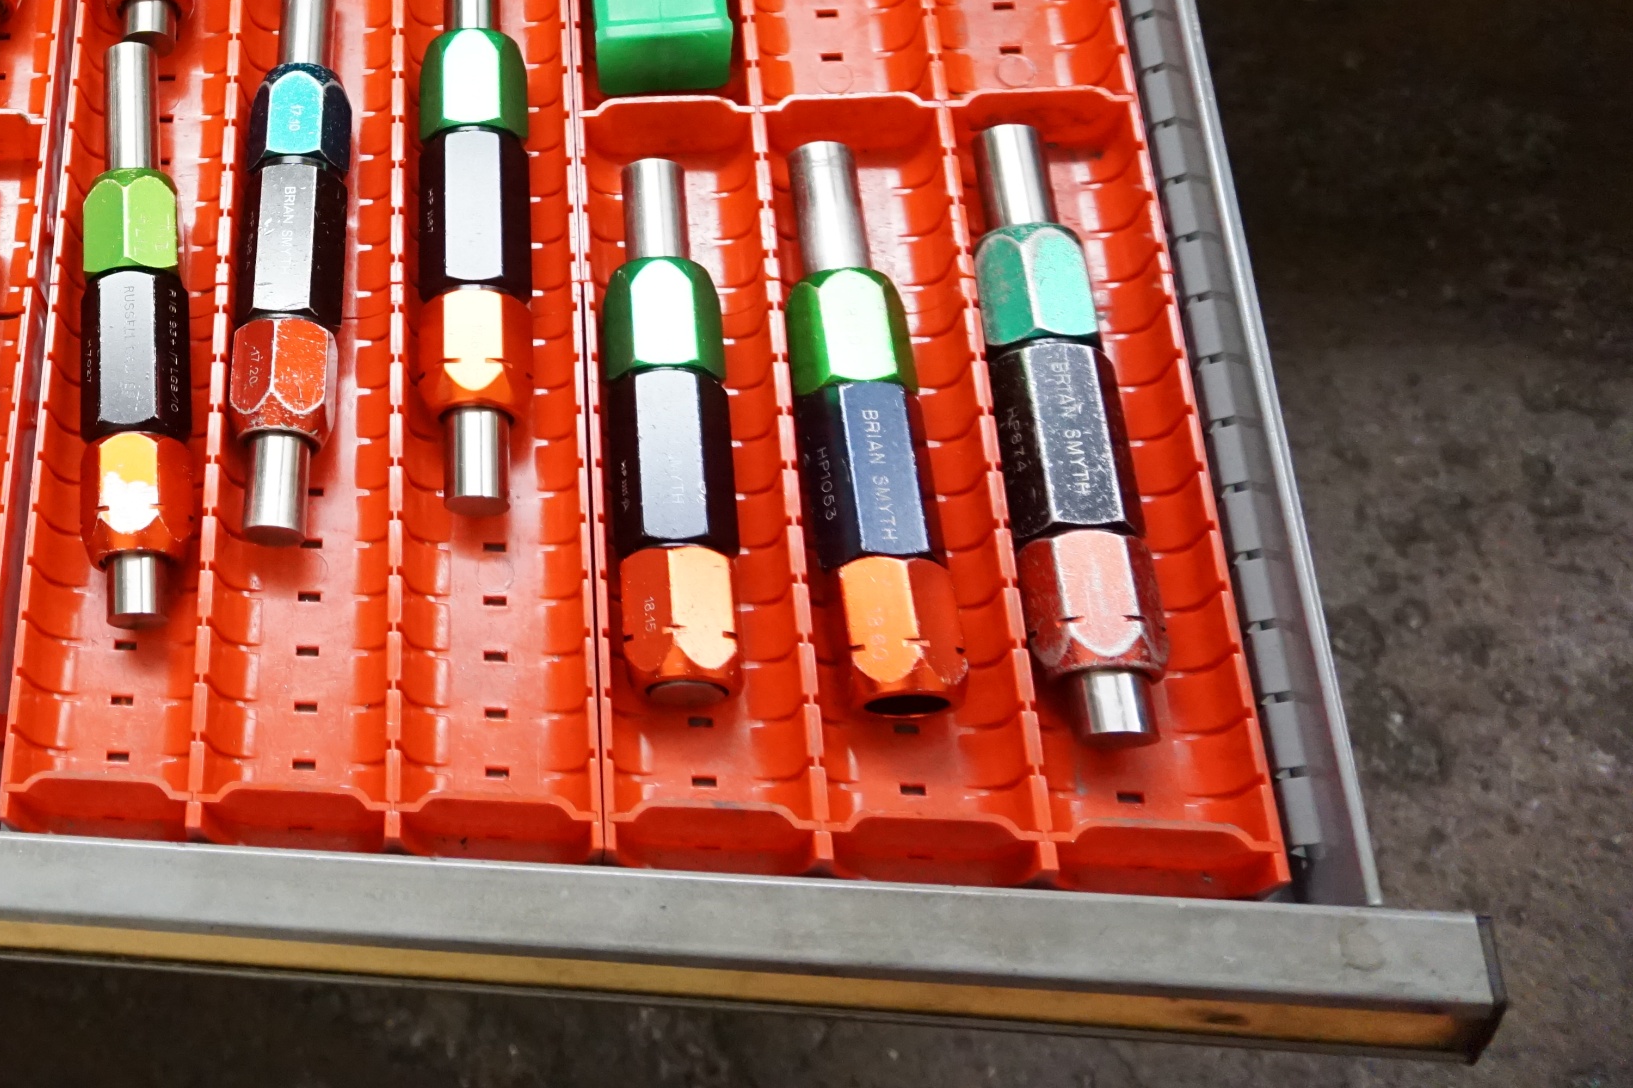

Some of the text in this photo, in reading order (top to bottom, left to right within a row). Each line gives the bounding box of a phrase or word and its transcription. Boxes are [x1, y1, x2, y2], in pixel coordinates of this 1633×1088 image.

[280, 186, 297, 276] BRIAN SMYTH
[1051, 361, 1092, 497] BRIAN SMYTH
[817, 446, 838, 522] HP1053
[861, 408, 899, 543] BRIAN SMYTH
[643, 596, 657, 633] 18.15
